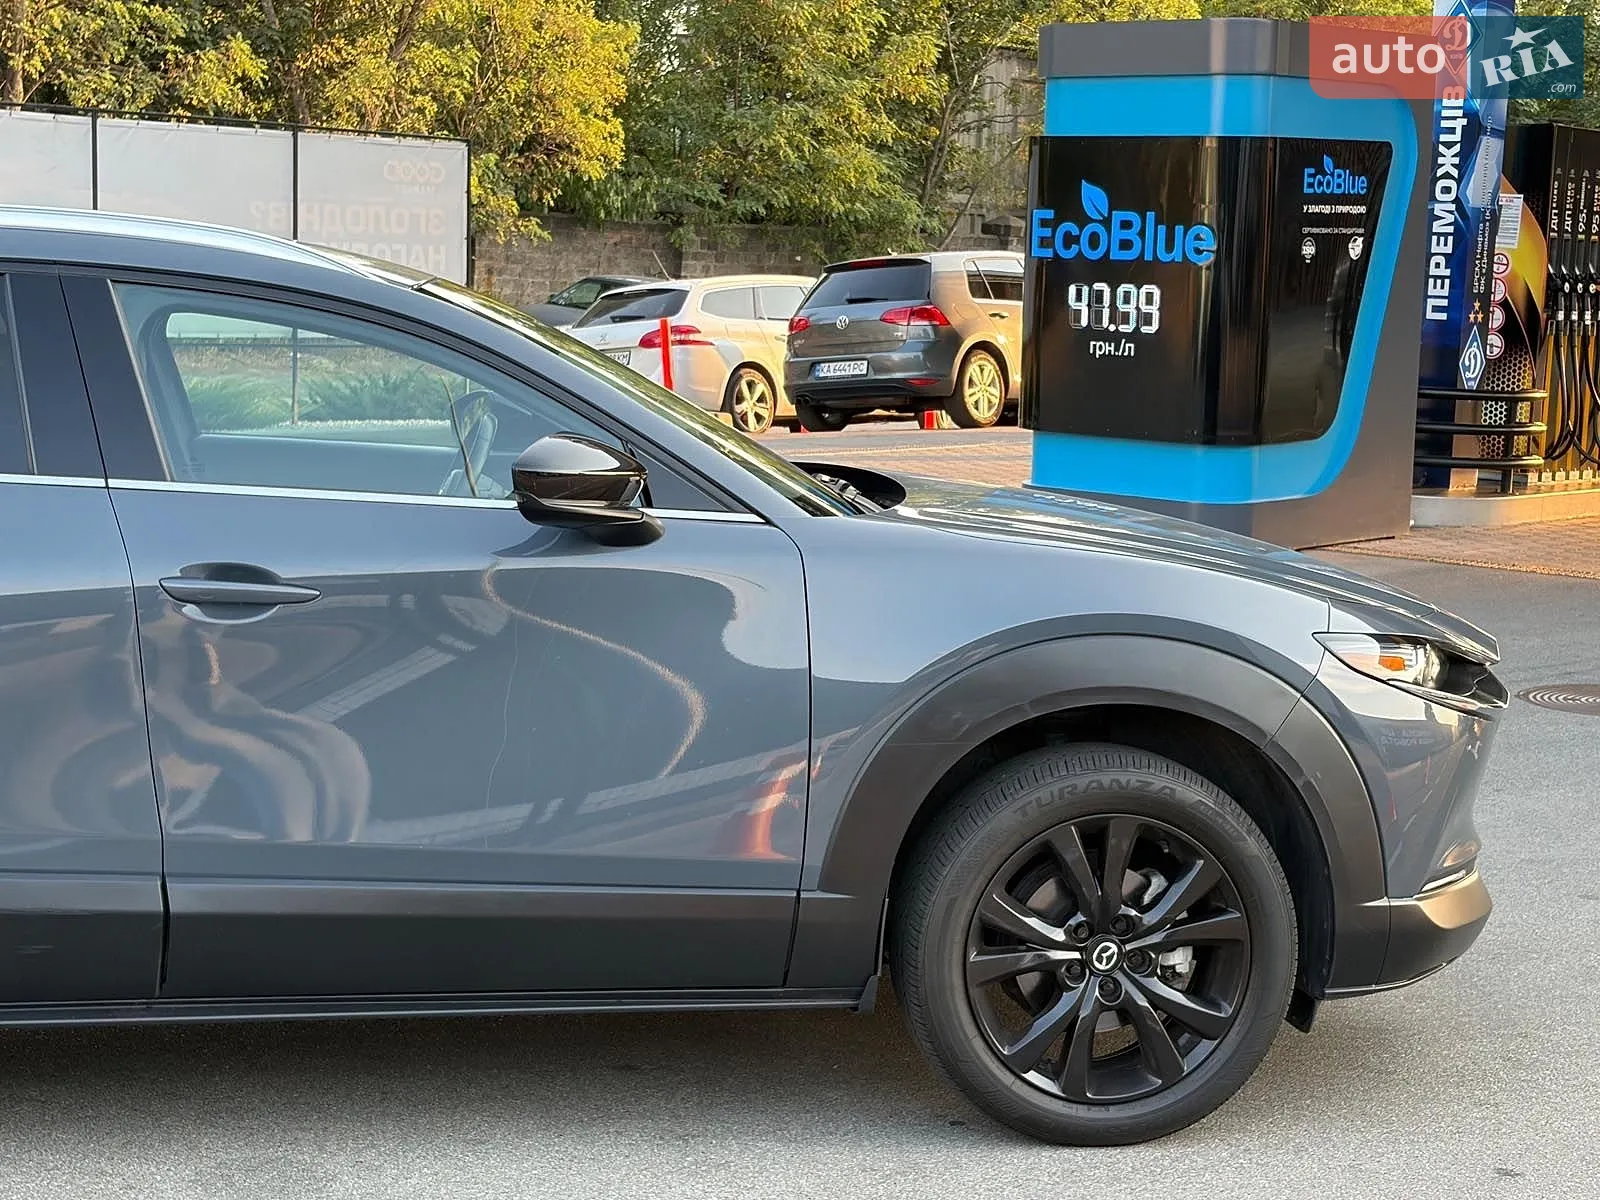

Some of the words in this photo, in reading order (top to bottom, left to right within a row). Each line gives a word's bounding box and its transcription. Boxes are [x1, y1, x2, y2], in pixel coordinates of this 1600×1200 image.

[1303, 168, 1367, 194] EcoBlue
[1426, 86, 1468, 320] ПЕРЕМОЖЦІВ
[1031, 209, 1216, 265] EcoBlue
[1591, 214, 1600, 234] 95
[1473, 262, 1481, 293] БРСМ
[1068, 283, 1161, 334] 47.99
[1089, 339, 1135, 358] грн./л
[1013, 778, 1177, 820] TURANZA
